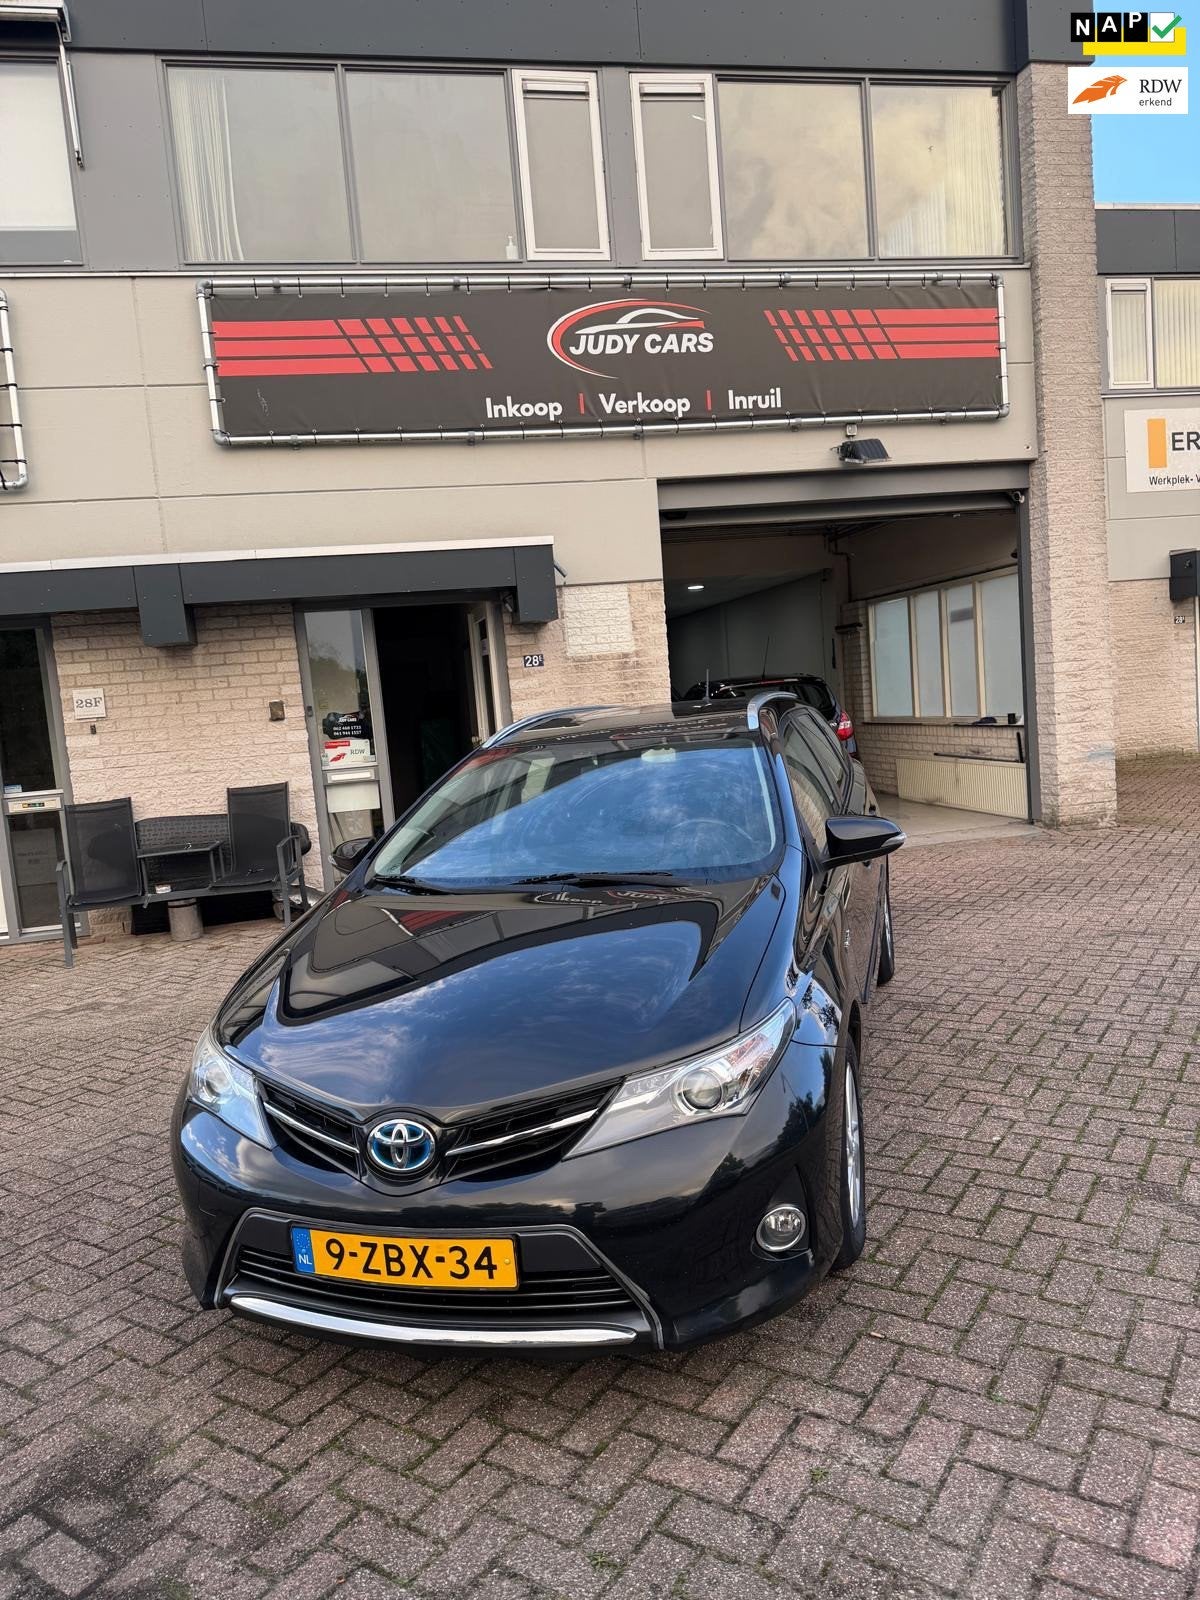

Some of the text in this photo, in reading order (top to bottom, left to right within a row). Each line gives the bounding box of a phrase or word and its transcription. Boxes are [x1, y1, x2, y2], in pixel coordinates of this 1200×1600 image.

[569, 332, 714, 355] JUDY CARS
[486, 388, 782, 421] Inkoop Verkoop Inruil
[75, 696, 102, 708] 28F
[298, 1238, 498, 1280] NL 9-ZBX-34
